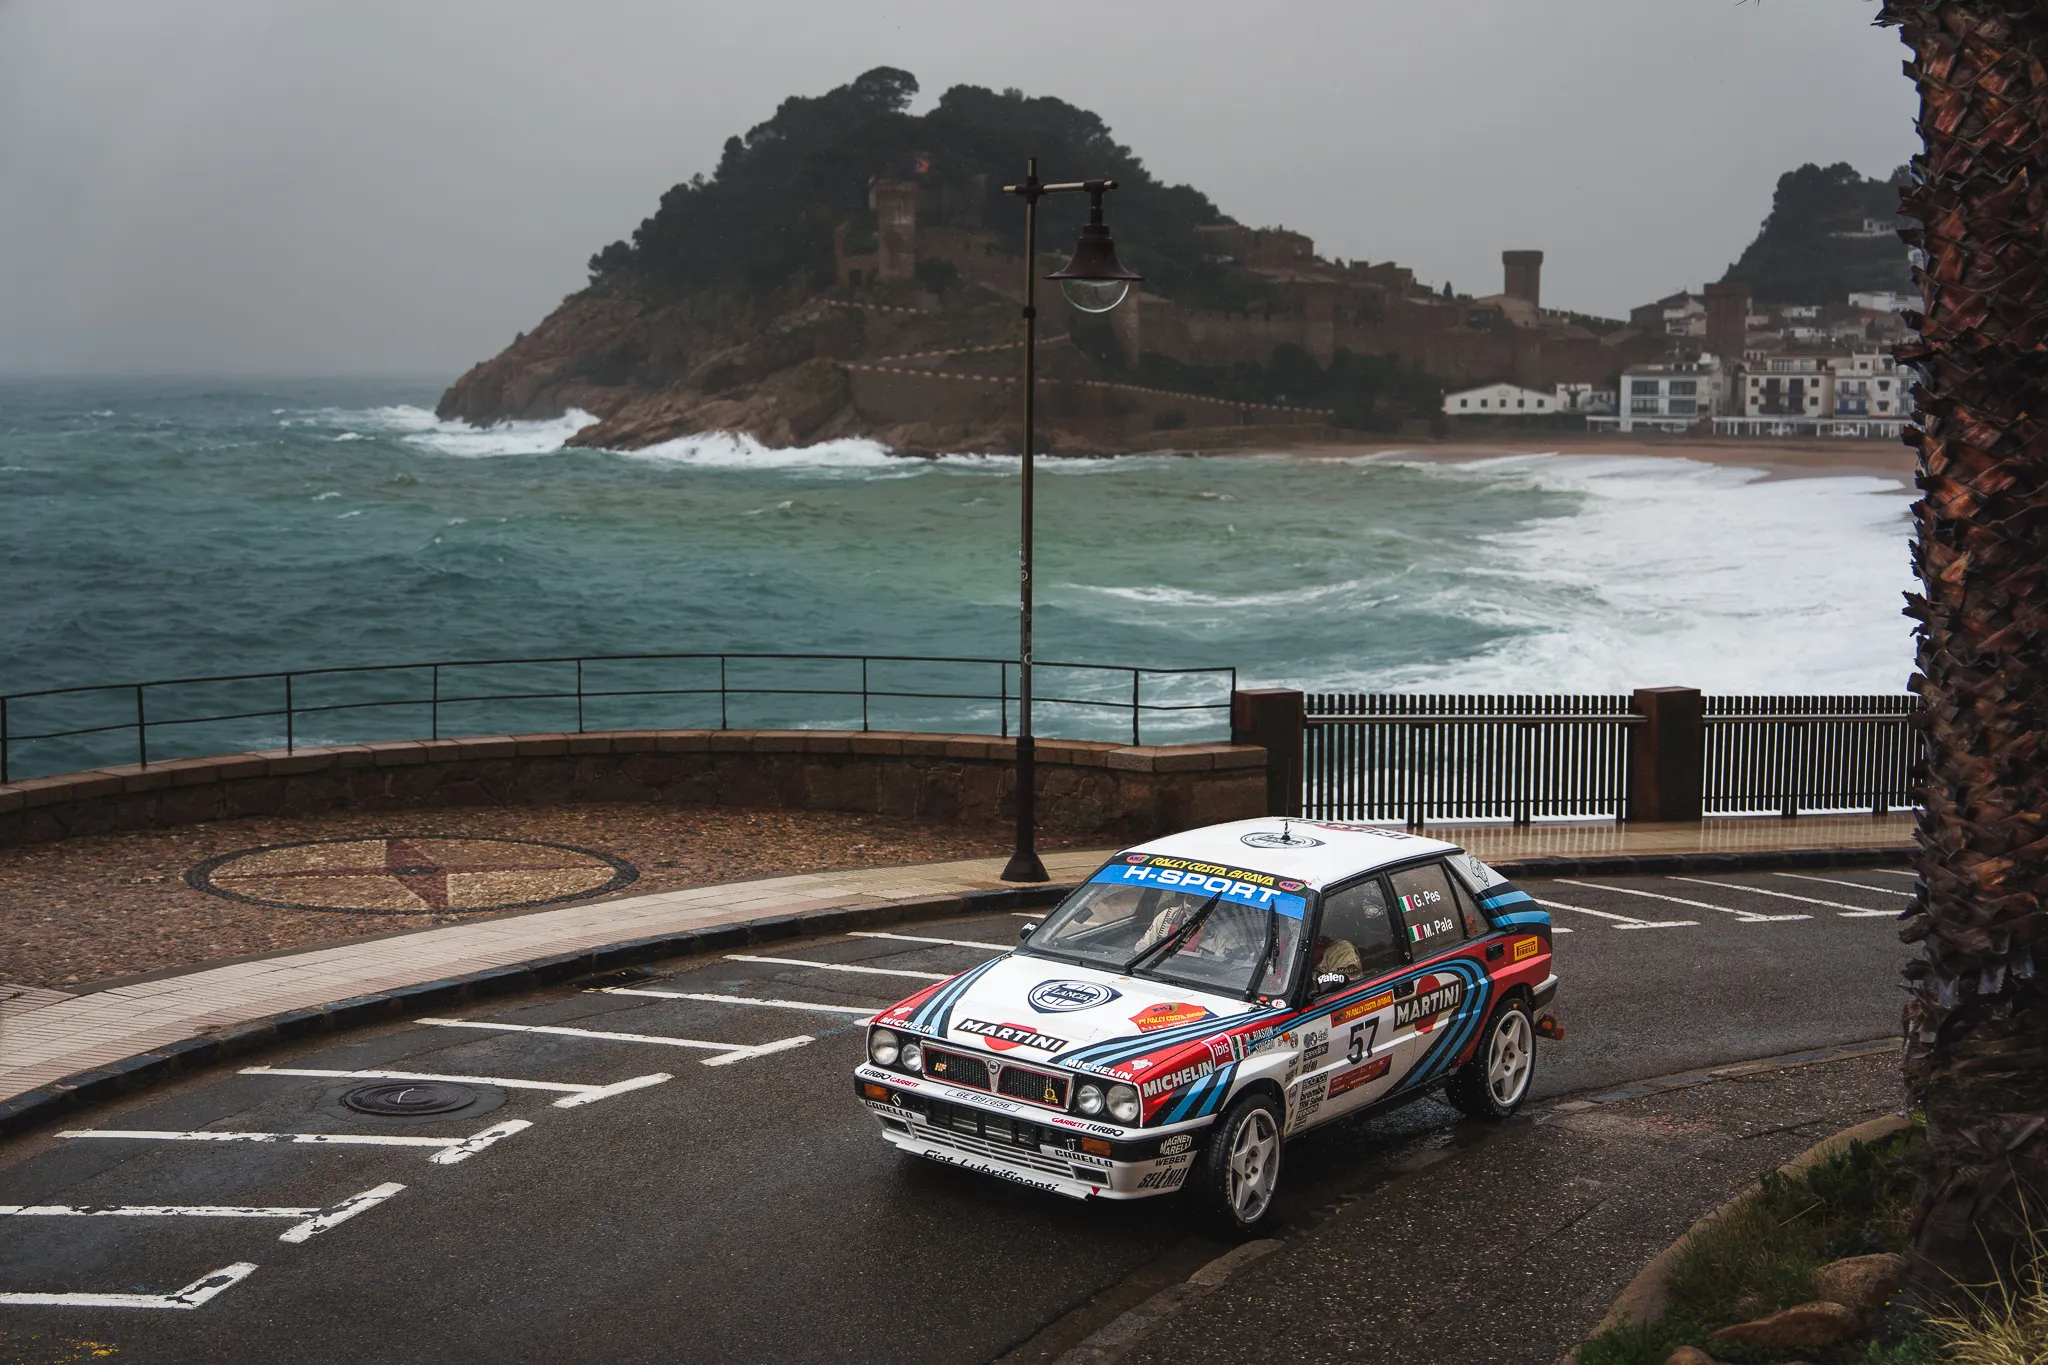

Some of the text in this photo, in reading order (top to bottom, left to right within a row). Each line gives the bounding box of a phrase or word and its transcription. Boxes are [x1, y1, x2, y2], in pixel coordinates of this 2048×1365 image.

[1149, 857, 1190, 870] RALLY
[1187, 862, 1227, 876] COSTA
[1227, 869, 1276, 887] BRAVA
[1123, 865, 1282, 903] H-SPORT
[1413, 889, 1441, 908] G. Pes
[1423, 917, 1454, 939] M. Pala
[1052, 988, 1091, 1003] LANCIA
[1395, 983, 1460, 1027] MARTINI
[880, 1017, 939, 1034] MICHELIN
[1147, 1015, 1166, 1024] RALLY
[960, 1019, 1065, 1053] MARTINI
[1347, 1016, 1380, 1065] 57
[1213, 1041, 1229, 1057] ibis
[859, 1068, 920, 1088] TURBO GARRETT
[1064, 1057, 1133, 1081] MICHELIN
[1142, 1060, 1214, 1098] MICHELIN
[1051, 1117, 1125, 1137] GARRETT TURBO
[923, 1149, 954, 1164] Fiat
[1054, 1149, 1114, 1168] CARELLO
[1155, 1155, 1188, 1167] WEBER
